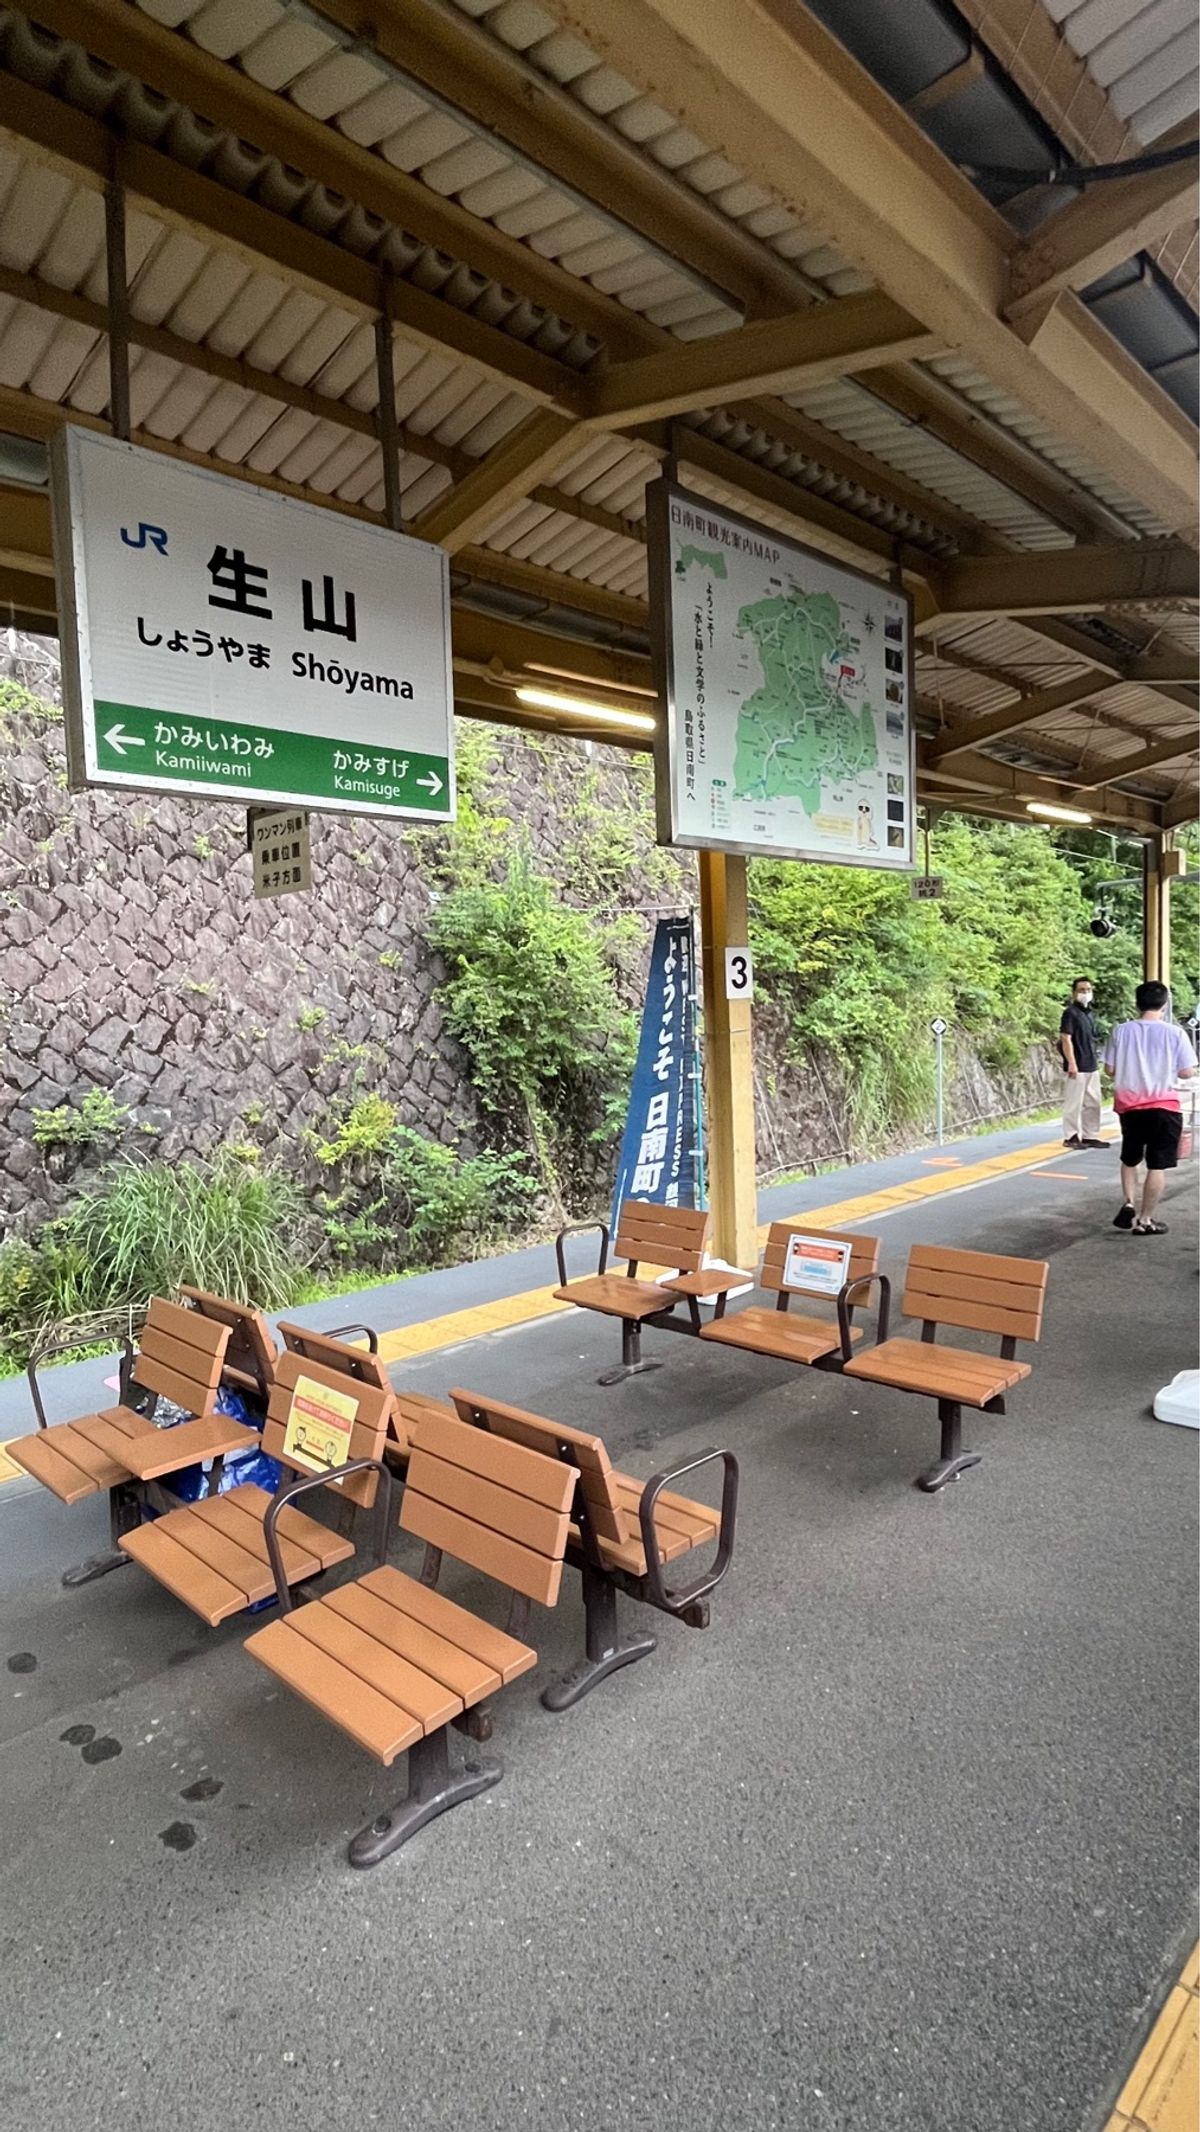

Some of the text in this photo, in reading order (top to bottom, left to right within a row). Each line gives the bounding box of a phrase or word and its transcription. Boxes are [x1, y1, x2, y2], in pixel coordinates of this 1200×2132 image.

[120, 522, 169, 556] JR
[206, 544, 358, 643] 生山
[136, 616, 414, 700] しょうやま Shōyama
[153, 721, 275, 759] かみいわみ
[155, 750, 252, 778] Kamiiwami
[333, 750, 409, 779] かみすげ
[333, 775, 401, 797] Kamisuge
[731, 956, 748, 990] 3
[652, 936, 678, 1081] ようこそ
